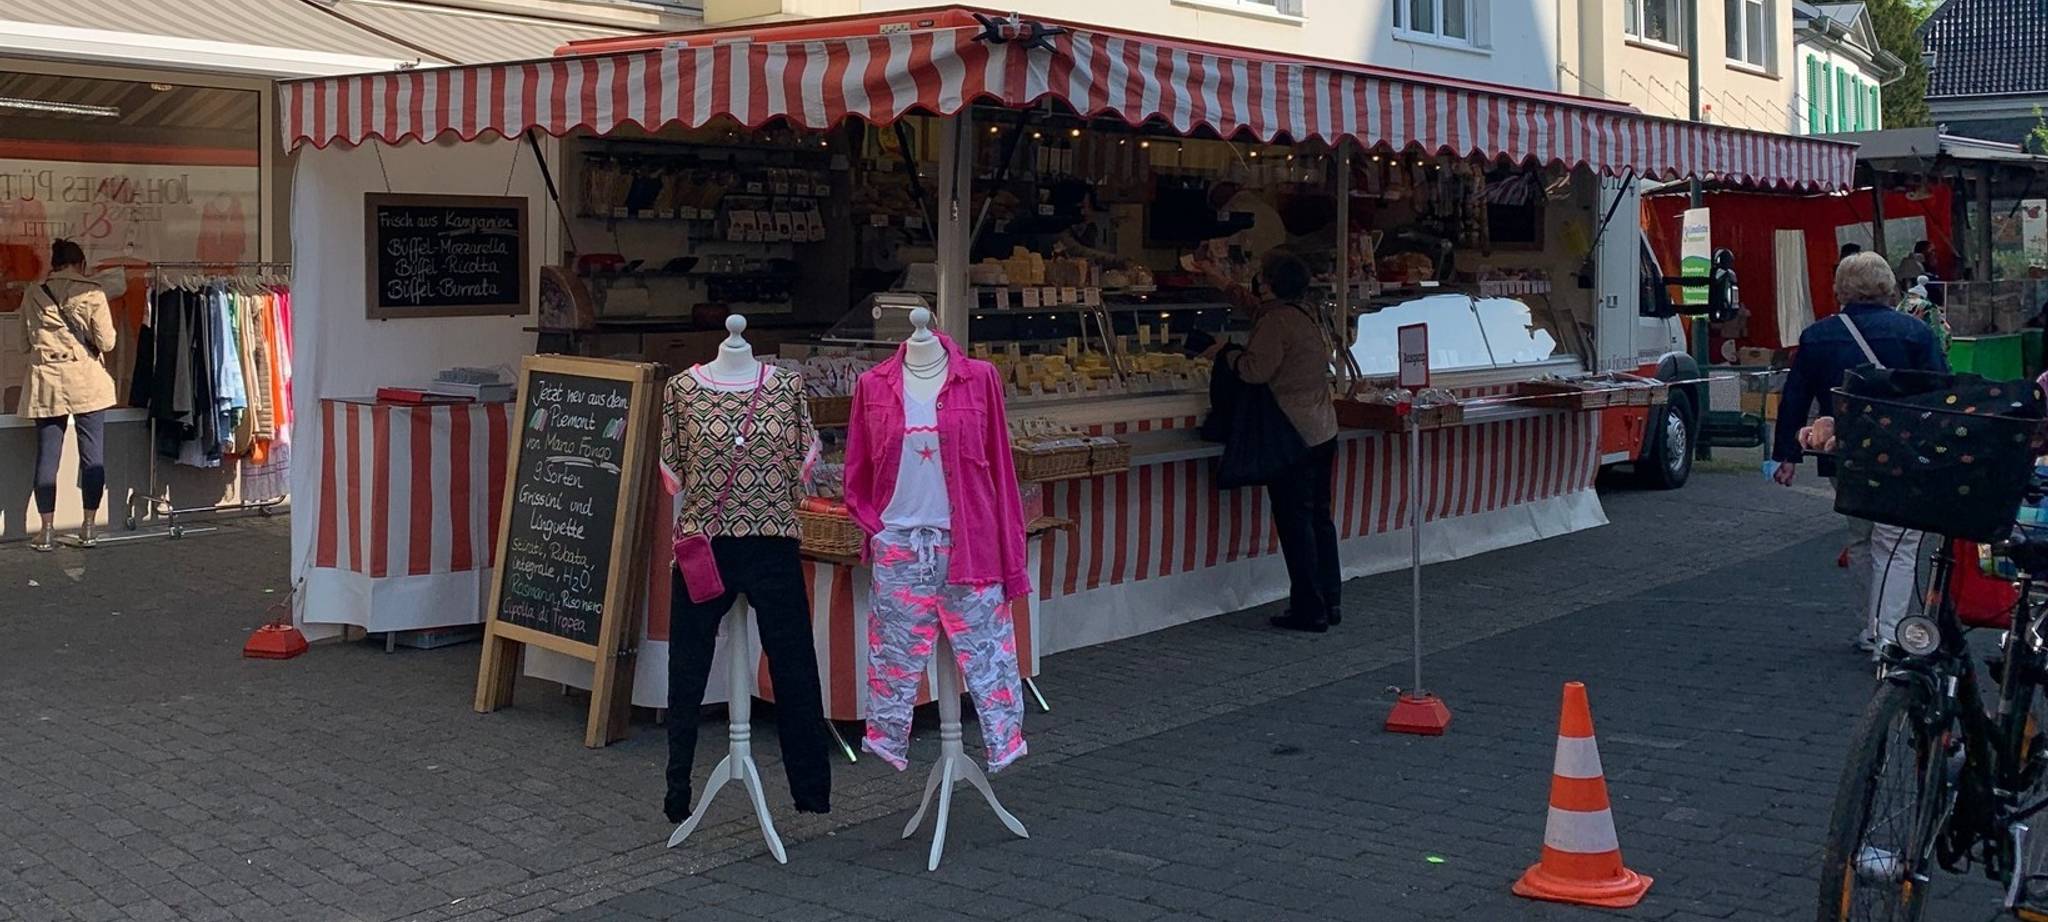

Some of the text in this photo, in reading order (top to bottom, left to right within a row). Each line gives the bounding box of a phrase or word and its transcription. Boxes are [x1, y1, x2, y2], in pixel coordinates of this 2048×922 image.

[379, 210, 513, 234] Frisch aus Kampanien
[533, 380, 563, 406] Jetzt
[588, 392, 605, 406] aus
[606, 389, 629, 410] dem
[550, 404, 596, 431] Piemont
[526, 437, 541, 450] von
[579, 436, 612, 467] Fongo
[533, 461, 584, 489] 9 Sorten
[519, 484, 594, 516] Grissini und
[530, 508, 585, 541] Linguette
[538, 605, 549, 623] di
[552, 607, 586, 633] Tropea
